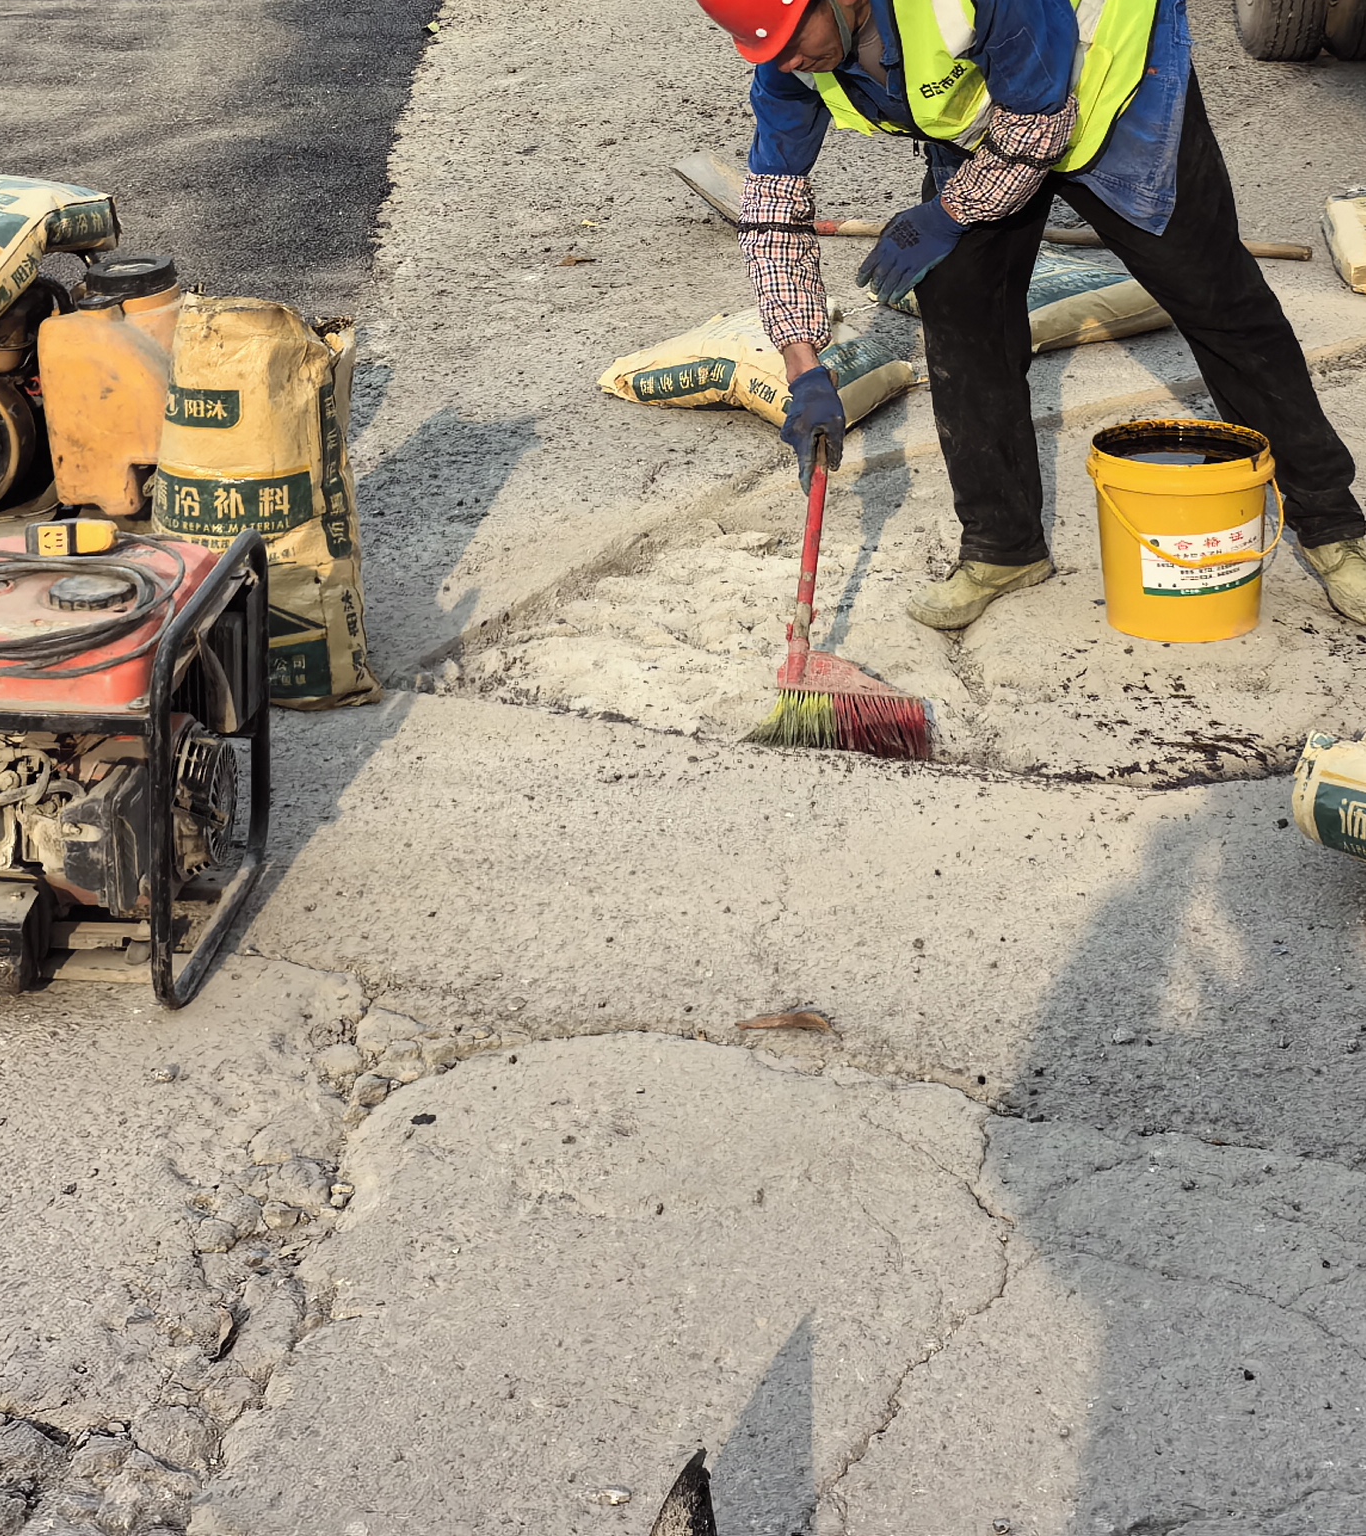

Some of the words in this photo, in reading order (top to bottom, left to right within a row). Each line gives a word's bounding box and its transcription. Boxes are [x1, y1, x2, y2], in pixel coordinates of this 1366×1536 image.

[184, 399, 228, 420] 阳沐
[1174, 530, 1244, 551] 合格证
